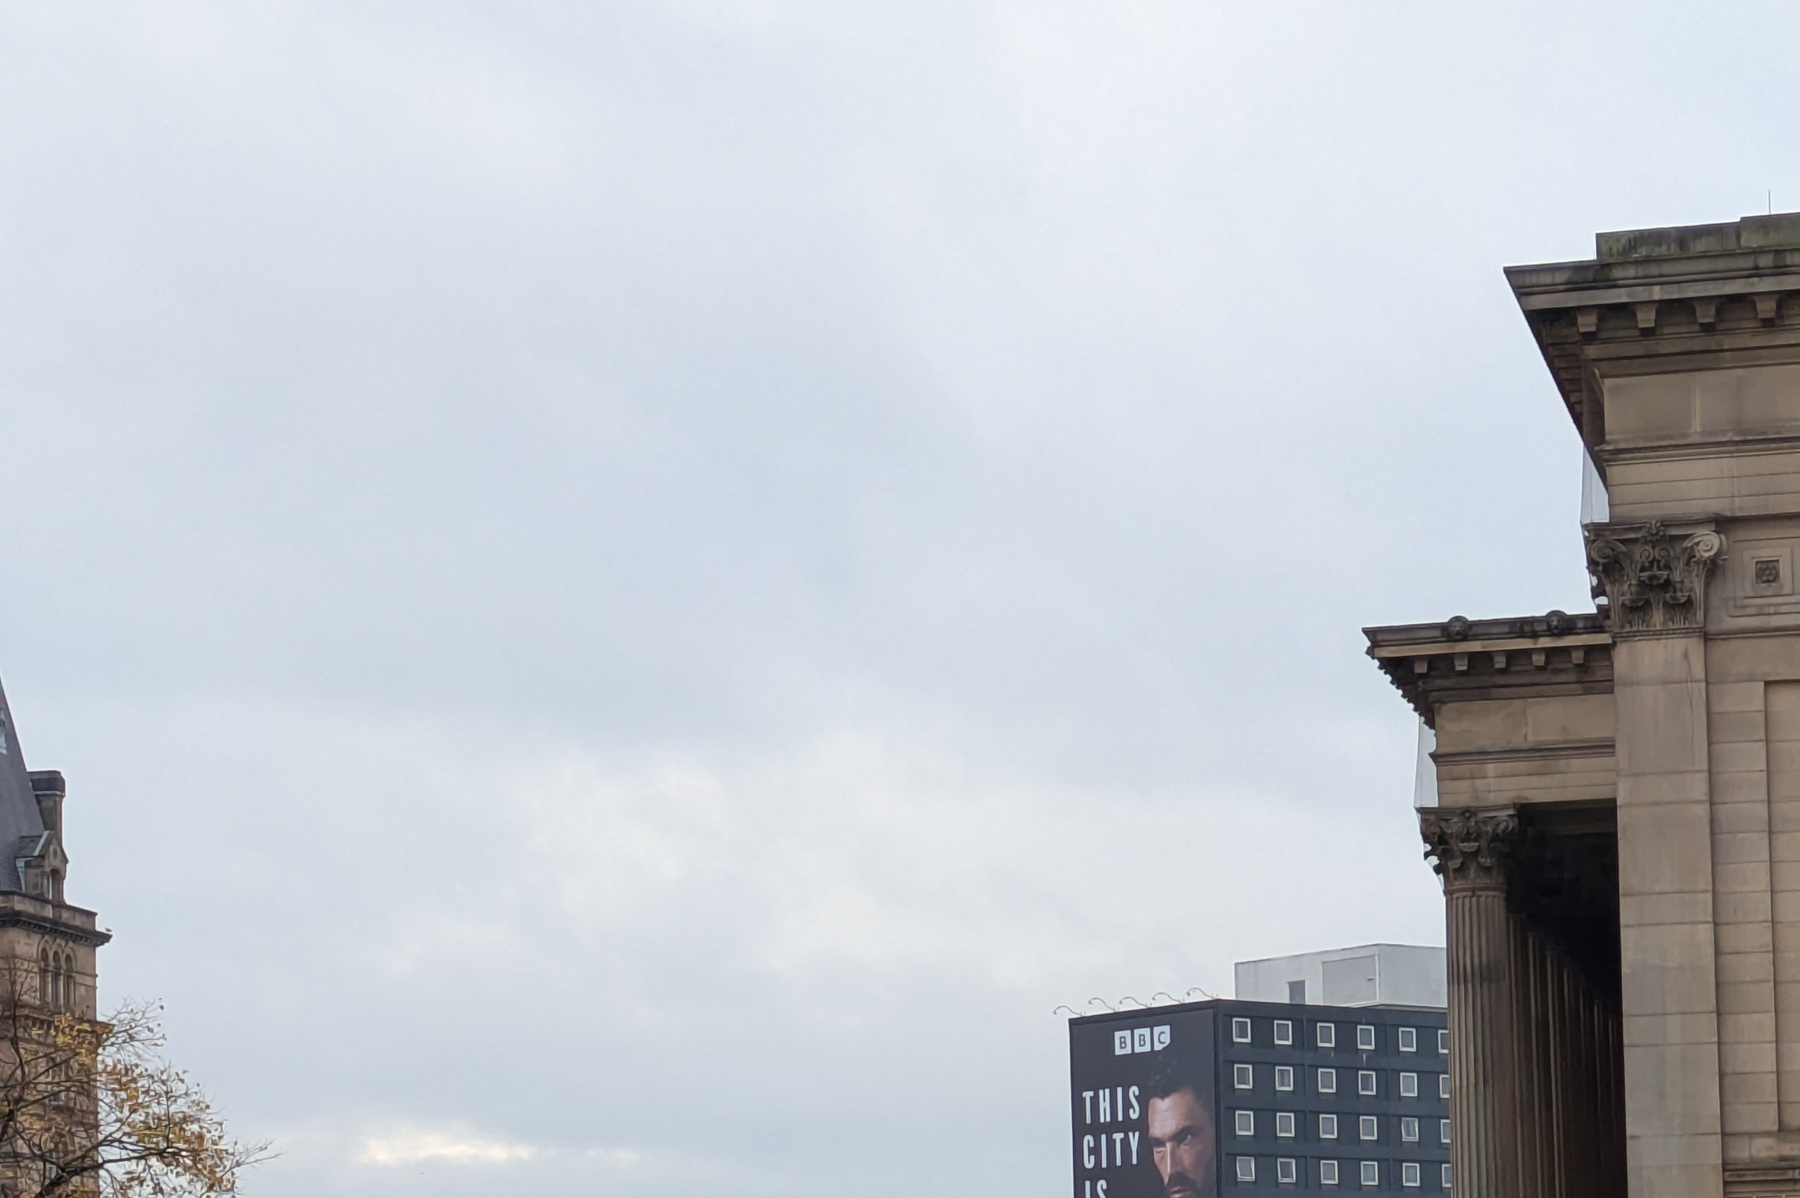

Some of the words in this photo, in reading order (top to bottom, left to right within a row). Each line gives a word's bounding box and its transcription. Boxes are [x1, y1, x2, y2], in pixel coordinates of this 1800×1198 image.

[1116, 1028, 1169, 1052] BBC
[1083, 1085, 1140, 1125] THIS
[1083, 1131, 1140, 1170] CITY
